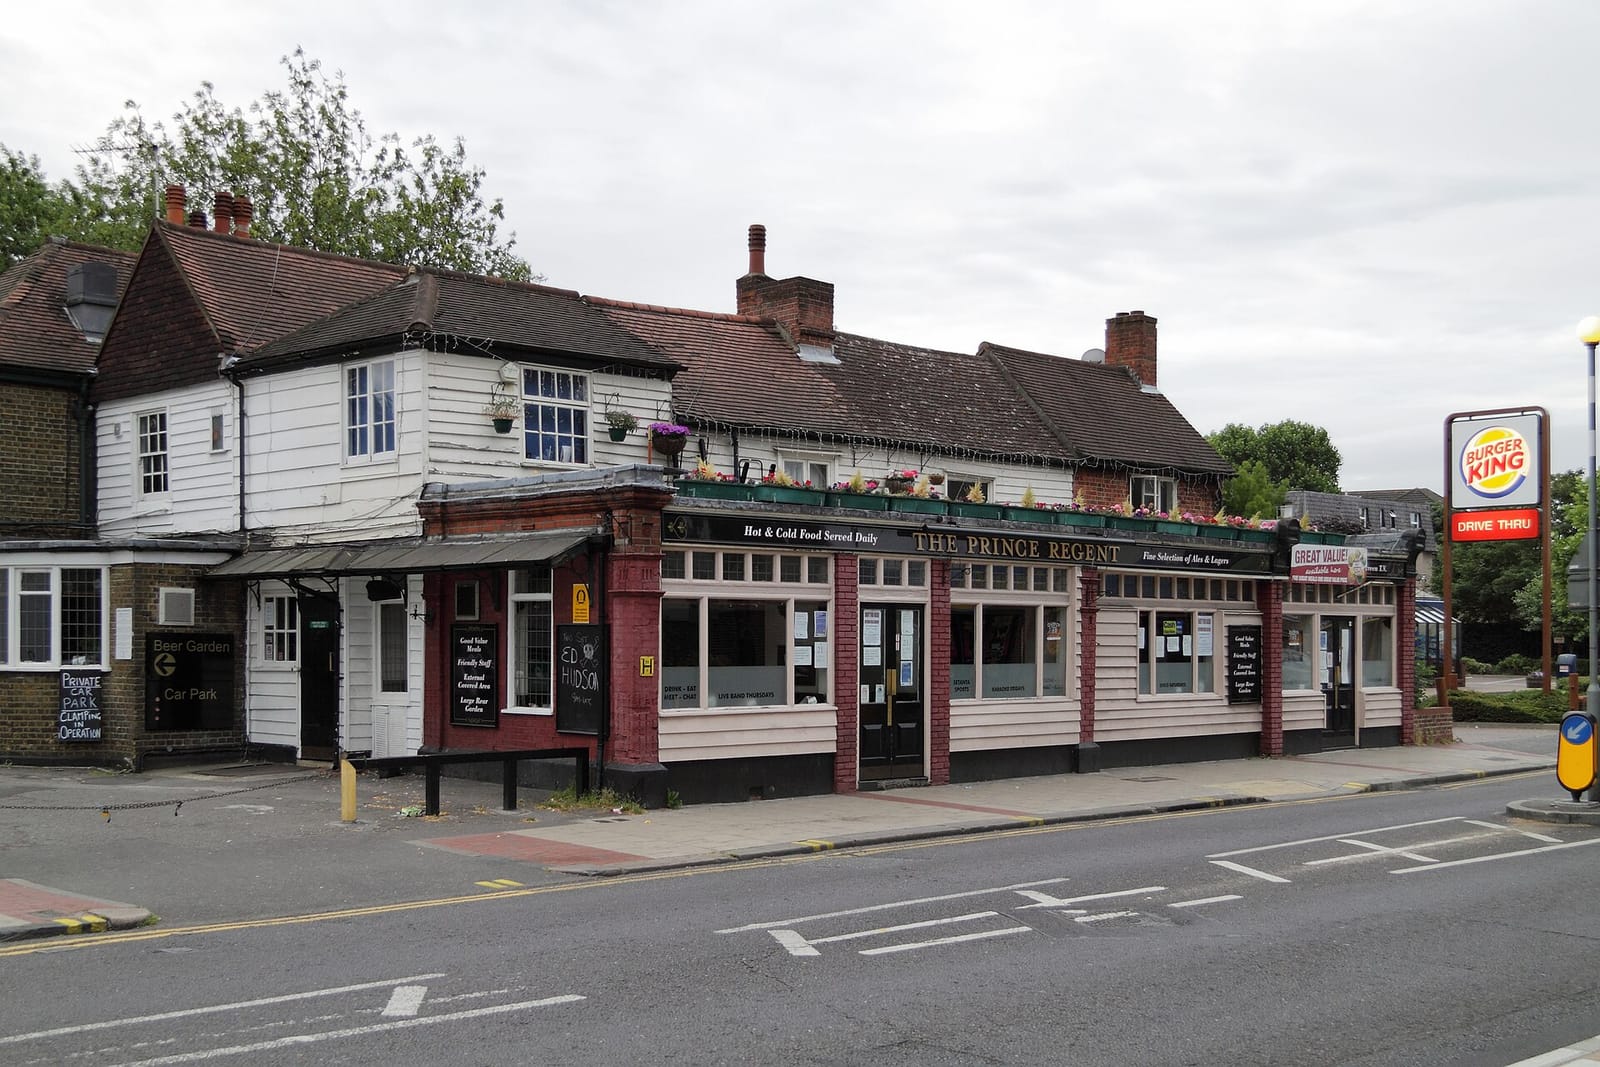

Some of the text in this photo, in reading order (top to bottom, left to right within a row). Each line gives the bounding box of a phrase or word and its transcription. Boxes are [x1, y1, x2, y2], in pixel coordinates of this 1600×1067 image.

[1466, 438, 1523, 465] BURGER
[1467, 451, 1525, 484] KING
[1458, 518, 1532, 532] DRIVE THRU
[744, 525, 879, 546] Hot & Cold Food Served Daily
[912, 532, 1121, 562] THE PRINCE REGENT
[1143, 551, 1157, 561] Fine
[1157, 551, 1184, 562] Selection
[1184, 553, 1193, 565] of
[1295, 548, 1348, 564] GREAT VALUE!
[153, 639, 230, 653] Beer Garden
[459, 637, 474, 645] Good
[560, 646, 578, 664] ED
[457, 659, 478, 668] Friendly
[642, 658, 653, 675] H
[62, 672, 102, 688] PRIVATE
[561, 666, 600, 692] HUDSON
[70, 687, 94, 697] CAR
[164, 688, 217, 701] Car Park
[63, 697, 98, 710] PARK
